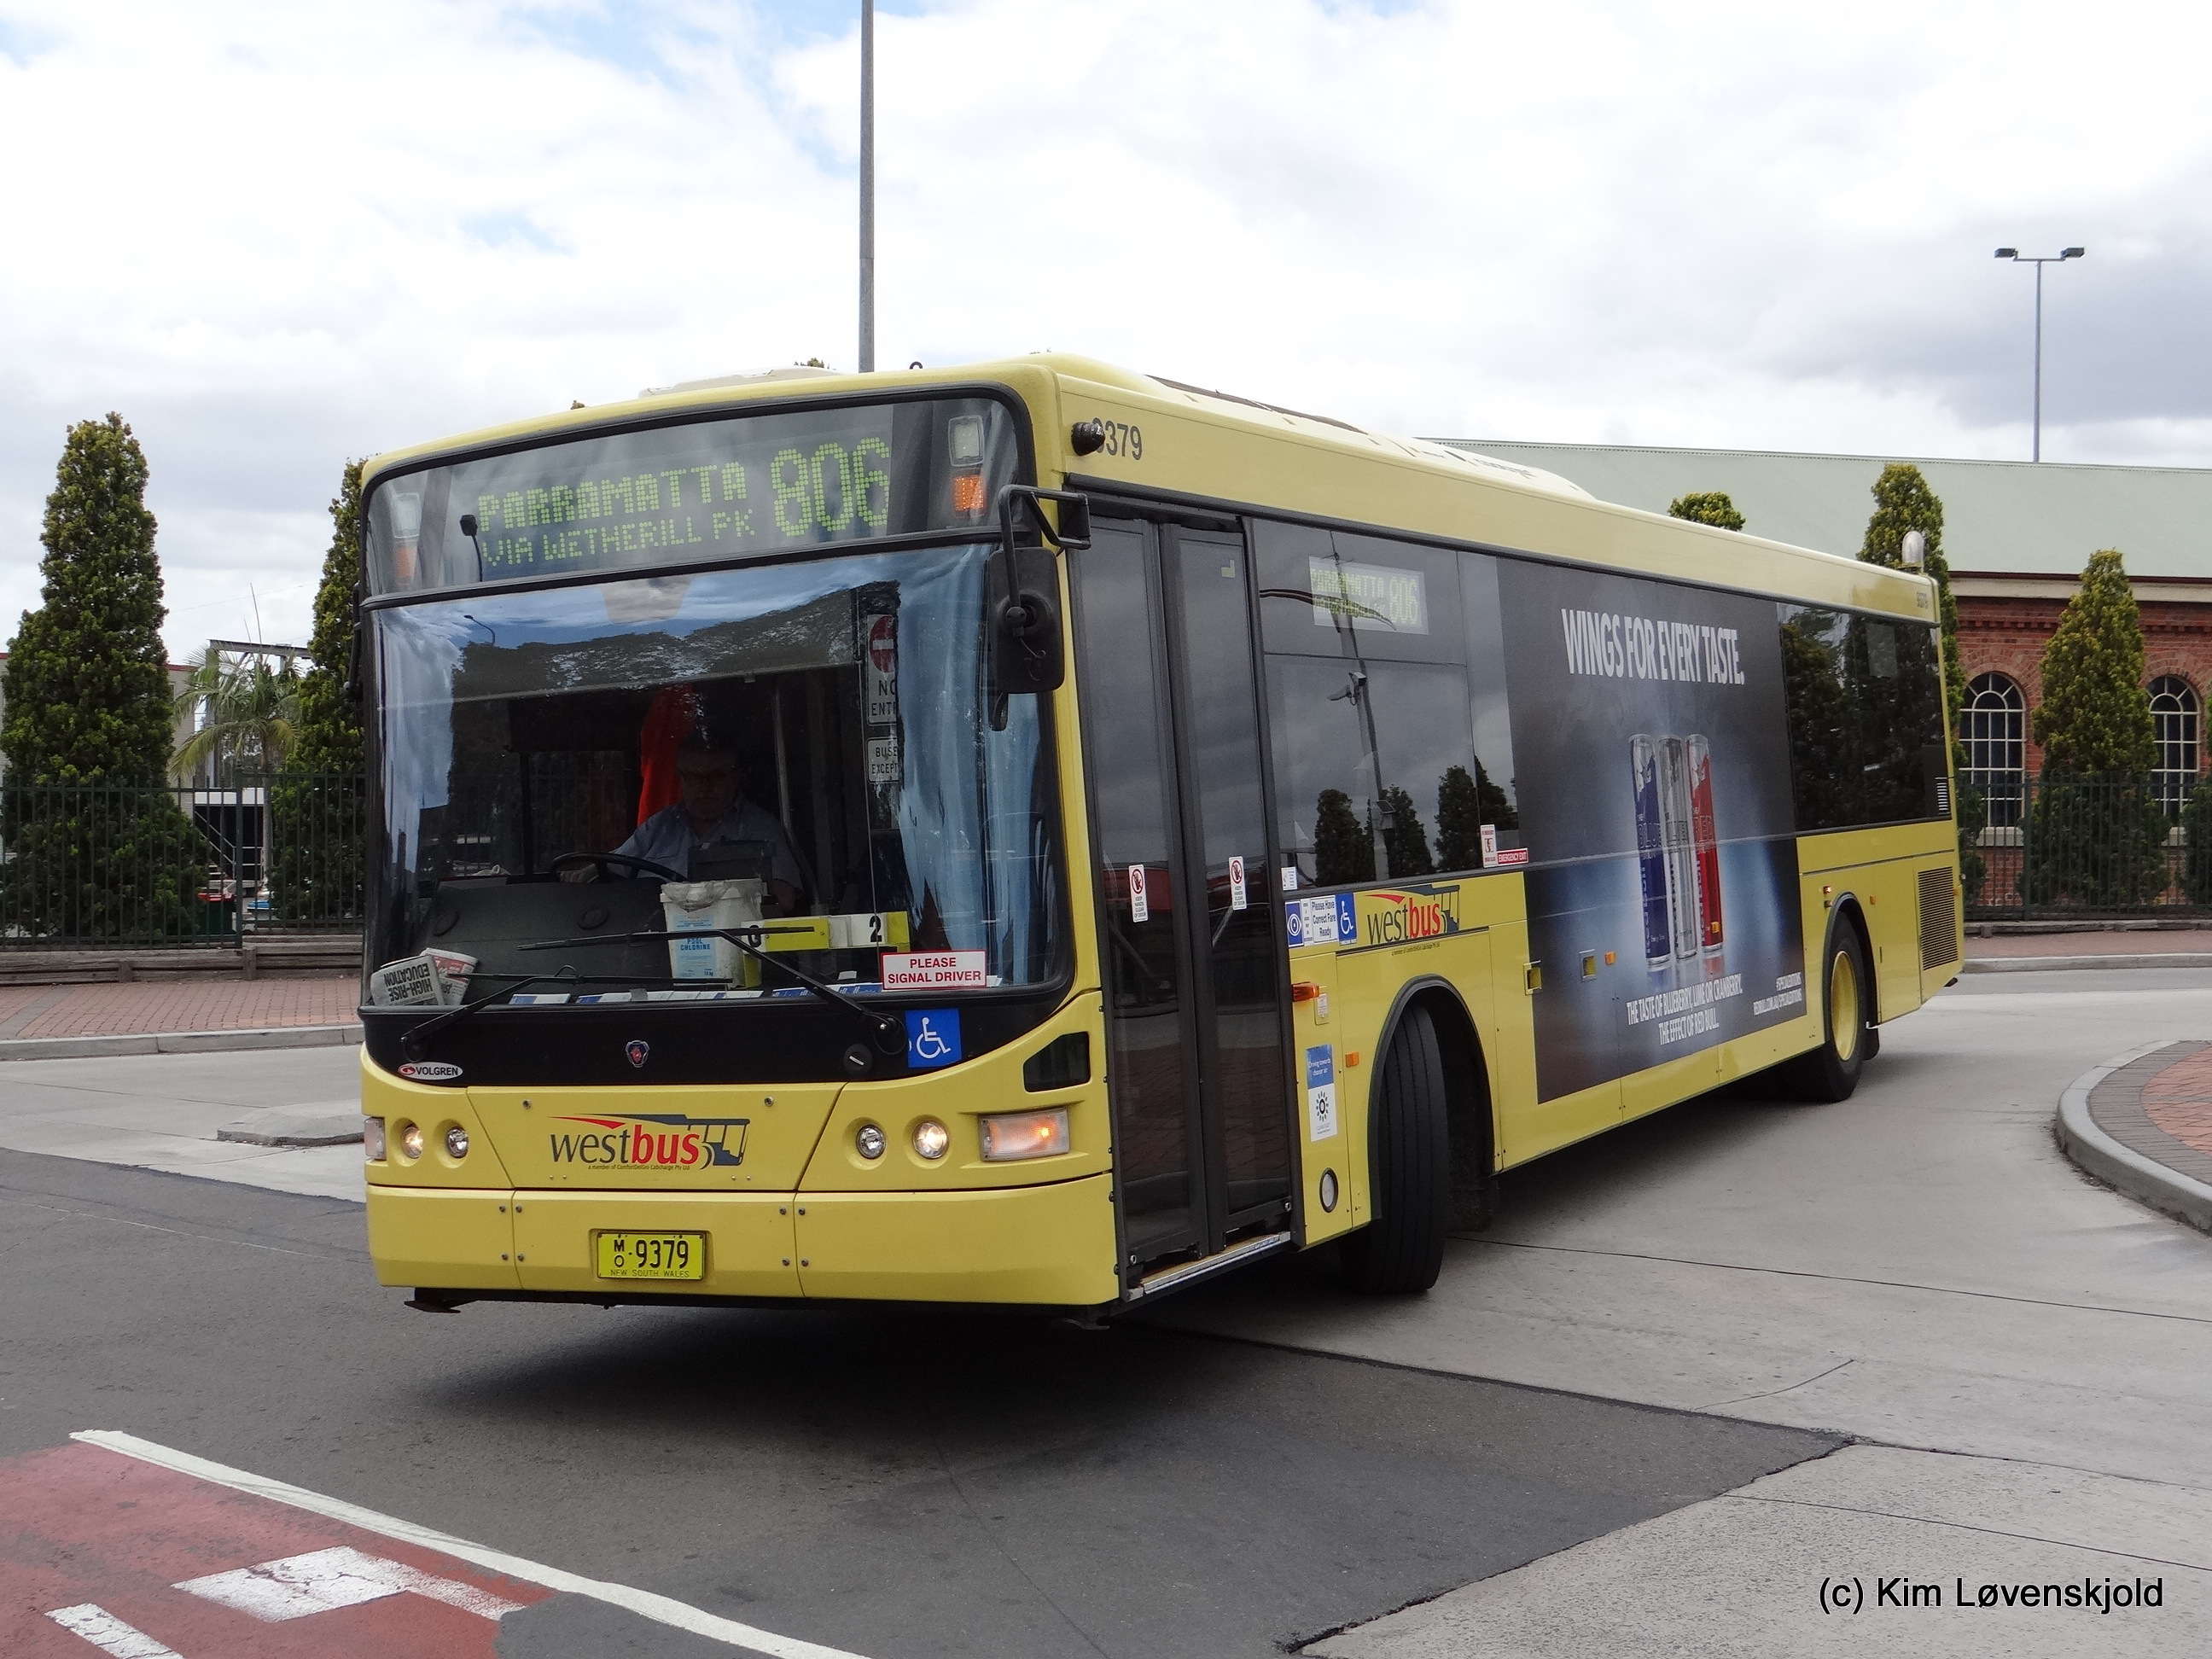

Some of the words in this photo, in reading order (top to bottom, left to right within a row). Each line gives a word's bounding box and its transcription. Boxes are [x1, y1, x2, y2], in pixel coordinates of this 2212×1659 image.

[478, 461, 748, 533] PARRAMATTA
[770, 436, 890, 537] 806
[481, 536, 534, 567] VIA
[542, 515, 703, 562] WETHERILL
[712, 508, 756, 541] PK
[1560, 608, 1625, 678] WINGS
[1623, 615, 1659, 680] FOR
[1656, 620, 1702, 683] EVERY
[1701, 626, 1745, 685] TASTE.
[869, 915, 882, 943] 2
[1366, 897, 1441, 945] westbus
[680, 943, 711, 952] CHLORINE
[383, 963, 431, 987] EDUCATION
[888, 972, 932, 984] SIGNAL
[934, 970, 982, 982] DRIVER
[909, 957, 958, 969] PLEASE
[387, 978, 434, 1002] HIGH-RISE
[1626, 1000, 1639, 1025] THE
[1639, 996, 1656, 1022] TASTE
[1655, 993, 1663, 1018] OF
[1692, 982, 1706, 1007] LIME
[1705, 981, 1714, 1004] OR
[1658, 1022, 1670, 1045] THE
[1669, 1016, 1687, 1042] EFFECT
[1686, 1014, 1694, 1037] OF
[1694, 1010, 1705, 1035] RED
[415, 1066, 459, 1076] VOLGREN
[550, 1124, 701, 1165] westbus
[635, 1239, 689, 1269] 9379
[632, 1269, 659, 1278] SOUTH
[663, 1270, 690, 1278] WALES
